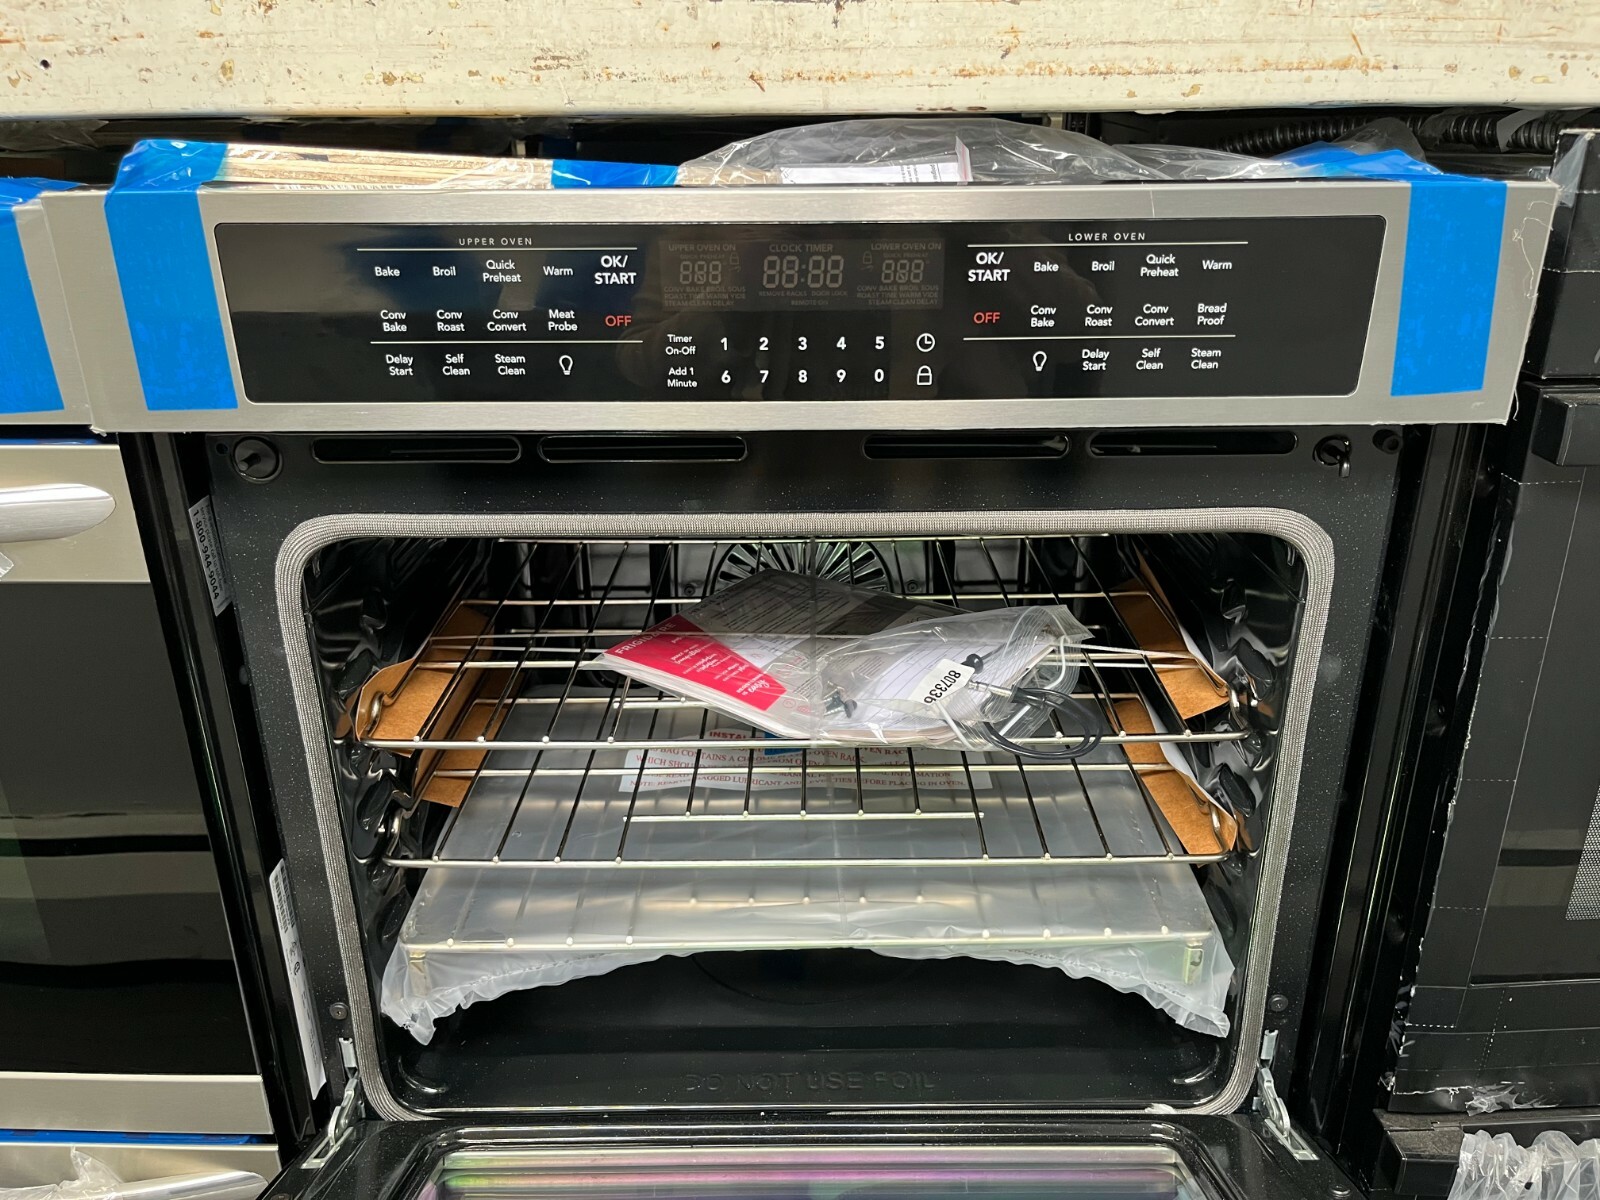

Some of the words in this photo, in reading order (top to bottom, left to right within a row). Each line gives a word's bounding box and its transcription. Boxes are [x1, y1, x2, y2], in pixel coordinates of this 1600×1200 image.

[1068, 233, 1108, 241] LOWER
[1113, 232, 1146, 241] OVEN
[458, 238, 496, 246] UPPER
[500, 238, 533, 246] OVEN
[871, 243, 900, 251] LOWER
[902, 242, 926, 250] OVEN
[927, 242, 942, 250] ON
[668, 244, 695, 252] UPPER
[697, 244, 721, 252] OVEN
[769, 244, 802, 252] CLOCK
[805, 244, 833, 252] TIMER
[600, 255, 629, 268] OK/
[976, 252, 1005, 265] OK/
[1146, 254, 1176, 265] Quick
[486, 260, 515, 270] Quick
[1033, 262, 1059, 272] Bake
[1091, 261, 1115, 271] Broil
[1202, 260, 1232, 270] Warm
[375, 266, 401, 277] Bake
[432, 266, 457, 277] Broil
[543, 266, 573, 276] Warm
[763, 255, 844, 288] 88:88
[968, 269, 1010, 282] START
[1140, 266, 1179, 277] Preheat
[483, 272, 521, 283] Preheat
[594, 272, 637, 285] START
[1030, 305, 1056, 315] Conv
[1086, 304, 1113, 315] Conv
[1143, 304, 1169, 314] Conv
[1197, 303, 1227, 314] Bread
[380, 310, 406, 320] Conv
[436, 310, 462, 320] Conv
[492, 309, 519, 319] Conv
[548, 309, 575, 319] Meat
[973, 312, 1000, 324] OFF
[605, 315, 632, 327] OFF
[1030, 317, 1055, 327] Bake
[1085, 317, 1112, 327] Roast
[1135, 316, 1174, 327] Convert
[1197, 315, 1225, 326] Proof
[383, 322, 407, 332] Bake
[437, 322, 465, 332] Roast
[487, 321, 527, 332] Convert
[548, 321, 578, 331] Probe
[667, 334, 692, 343] Timer
[720, 337, 729, 350] 1
[759, 337, 769, 351] 2
[798, 337, 808, 351] 3
[836, 337, 847, 350] 4
[875, 336, 885, 349] 5
[665, 346, 696, 355] On-Off
[1081, 349, 1110, 361] Delay
[1141, 348, 1161, 358] Self
[1191, 348, 1222, 358] Steam
[385, 354, 413, 366] Delay
[445, 354, 464, 364] Self
[495, 354, 526, 364] Steam
[1082, 361, 1106, 371] Start
[1136, 360, 1163, 370] Clean
[1191, 360, 1218, 370] Clean
[389, 366, 413, 376] Start
[442, 366, 470, 376] Clean
[497, 366, 526, 376] Clean
[668, 367, 688, 376] Add
[689, 367, 694, 376] 1
[721, 370, 731, 383] 6
[759, 370, 769, 383] 7
[798, 369, 808, 383] 8
[836, 369, 847, 382] 9
[874, 368, 884, 382] 0
[667, 378, 698, 388] Minute
[193, 509, 220, 600] 1-800-944-9044
[615, 622, 677, 655] FRIGIDARE
[923, 669, 962, 704] 807336
[737, 1072, 795, 1091] NOT
[807, 1071, 865, 1090] USE
[874, 1070, 936, 1090] FOIL
